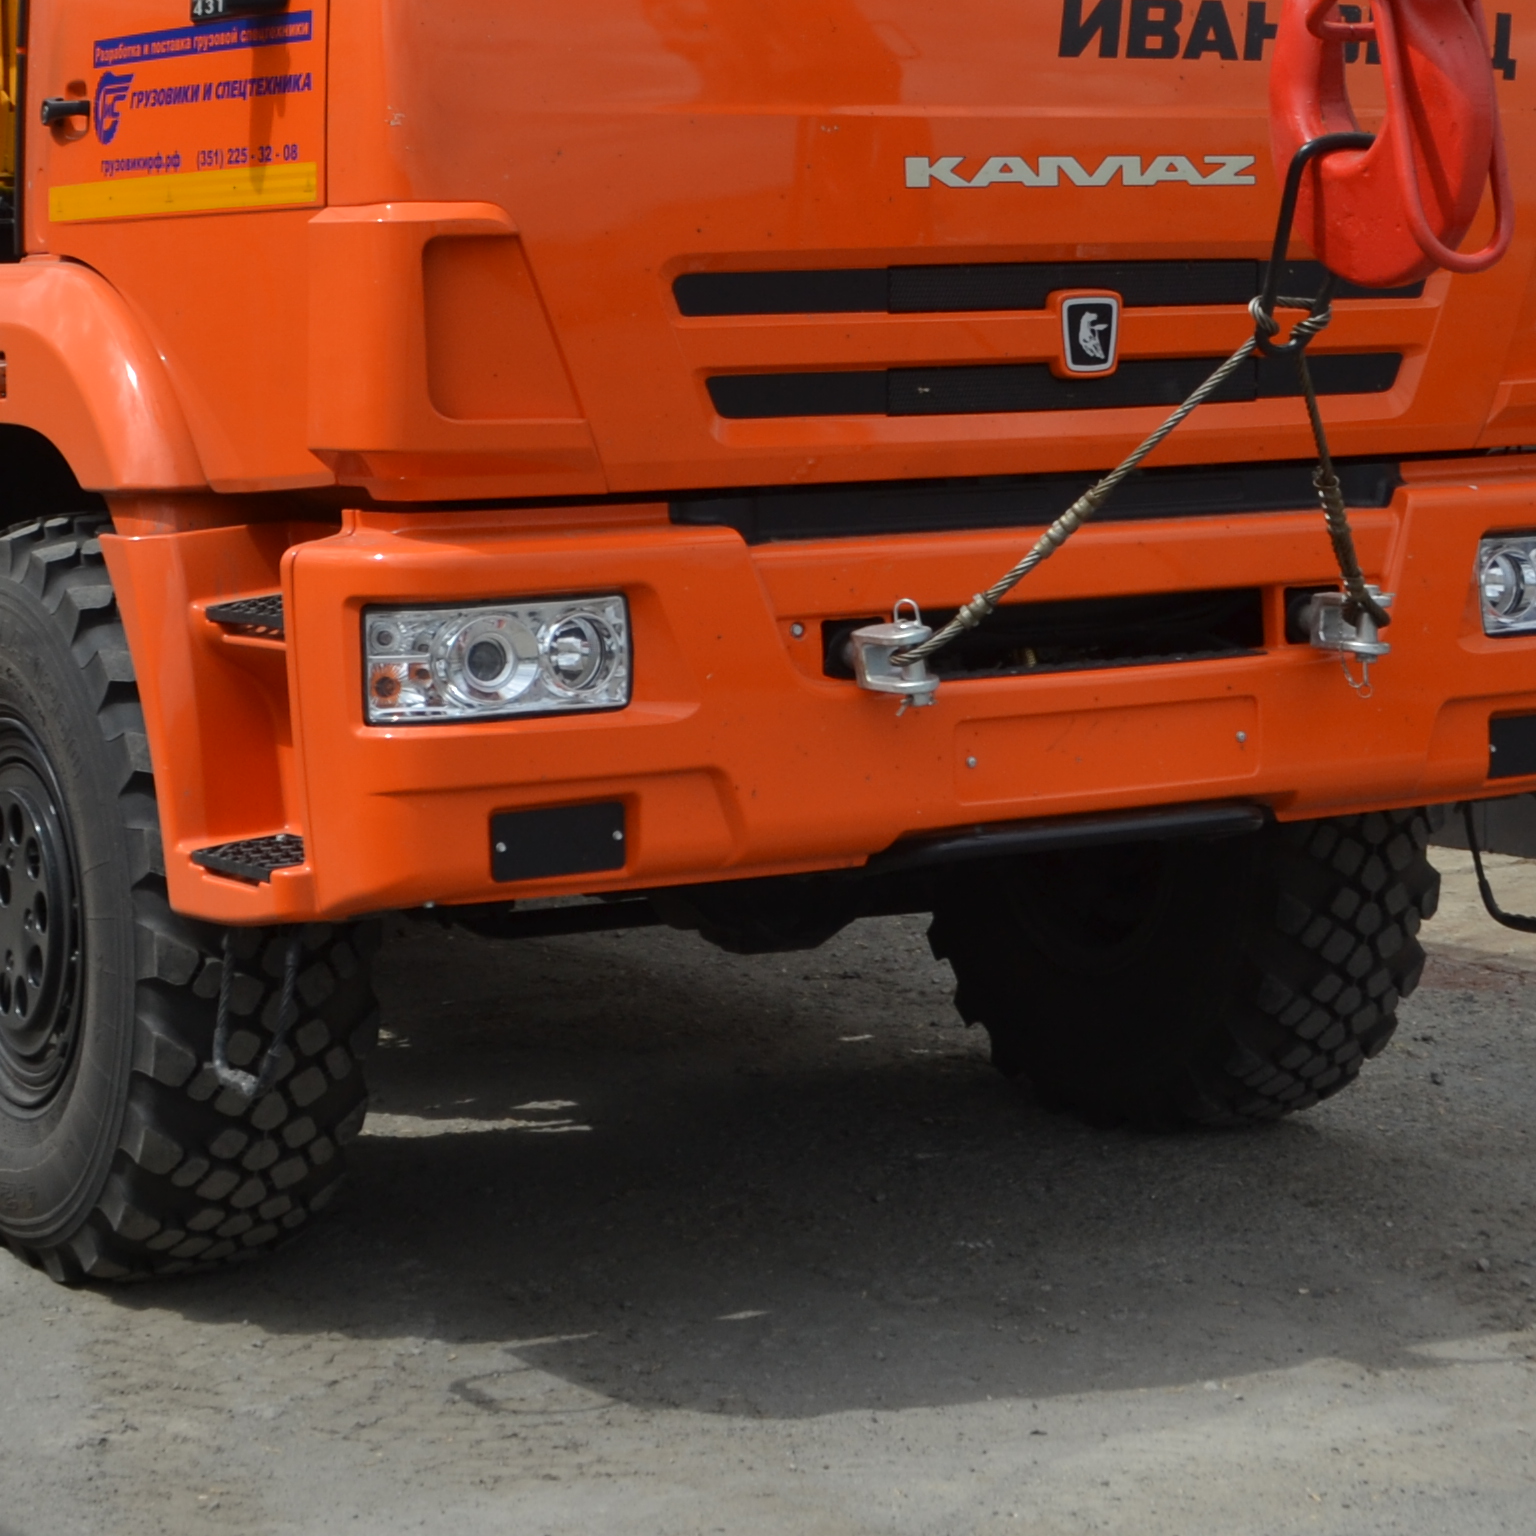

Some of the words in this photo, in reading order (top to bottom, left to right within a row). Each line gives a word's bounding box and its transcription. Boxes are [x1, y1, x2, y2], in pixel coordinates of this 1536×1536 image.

[95, 41, 141, 63] Разработка
[143, 45, 149, 55] и
[151, 37, 192, 54] поставка
[193, 27, 238, 52] грузовой
[240, 21, 310, 43] спецтехники
[129, 83, 200, 109] ГРУЗОВИКИ
[203, 82, 213, 101] И
[215, 72, 312, 100] СПЕЦТЕХНИКА
[196, 149, 224, 169] (351)
[227, 147, 248, 165] 225
[258, 146, 272, 163] 32
[283, 144, 298, 161] 08
[905, 155, 1255, 188] KAMAZ
